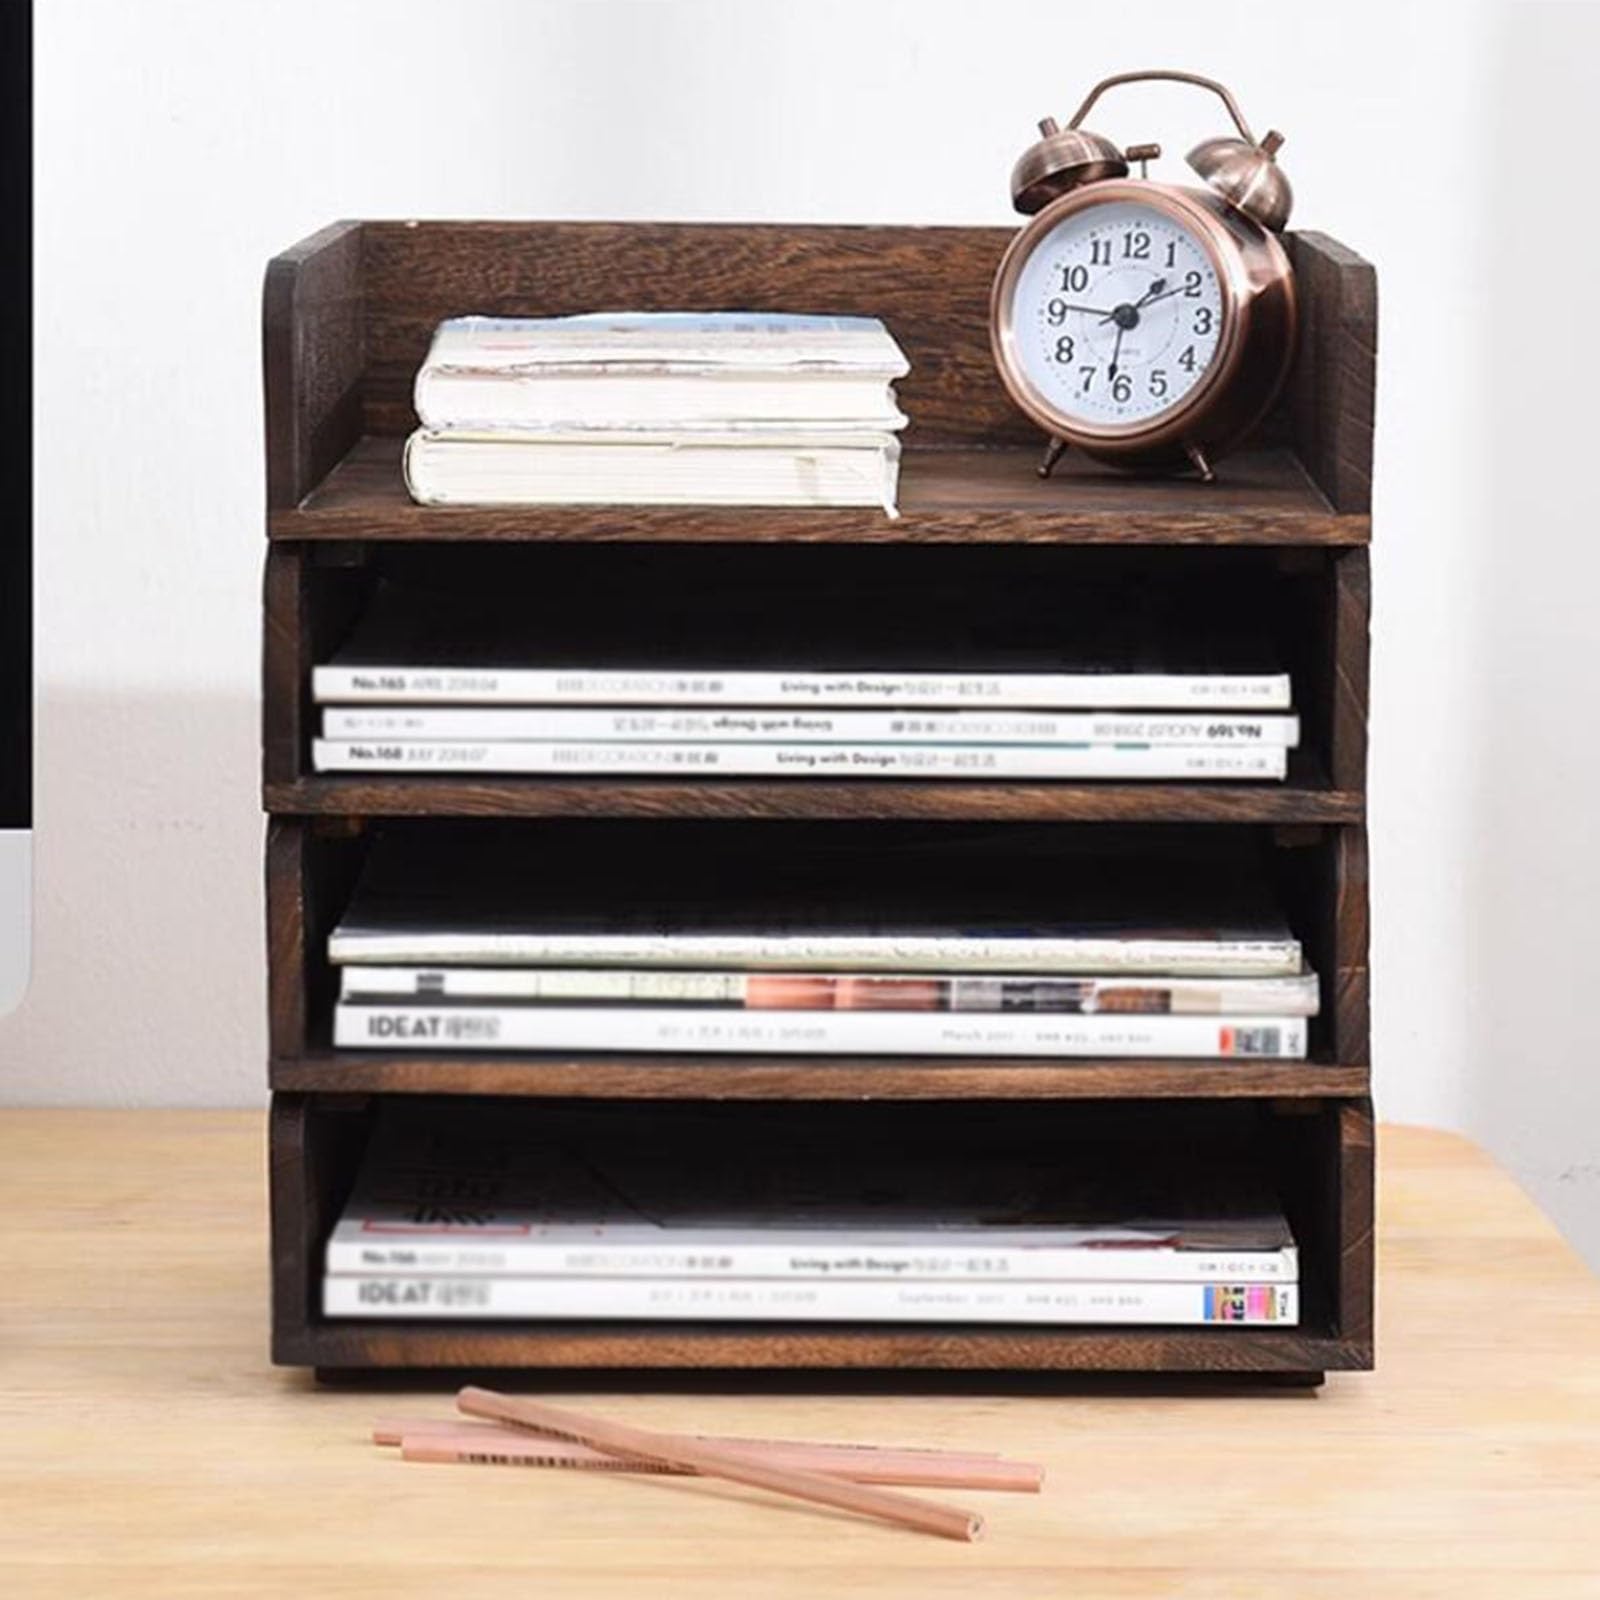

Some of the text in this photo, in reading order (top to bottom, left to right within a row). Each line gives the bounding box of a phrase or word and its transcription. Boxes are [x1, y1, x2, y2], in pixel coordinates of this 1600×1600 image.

[1090, 240, 1112, 266] 11
[1122, 232, 1151, 259] 12
[1165, 242, 1175, 268] 1
[1060, 265, 1089, 292] 10
[1184, 271, 1202, 297] 2
[1048, 299, 1067, 326] 9
[1193, 307, 1212, 335] 3
[1055, 336, 1074, 364] 8
[1178, 346, 1197, 372] 4
[1079, 366, 1097, 392] 7
[1112, 375, 1132, 402] 6
[1149, 370, 1167, 396] 5
[824, 681, 853, 691] with
[857, 681, 901, 696] Design
[1206, 724, 1262, 738] No.169
[820, 752, 849, 763] with
[852, 752, 896, 767] Design
[368, 1015, 440, 1037] IDEAT
[358, 1283, 431, 1304] IDEAT
